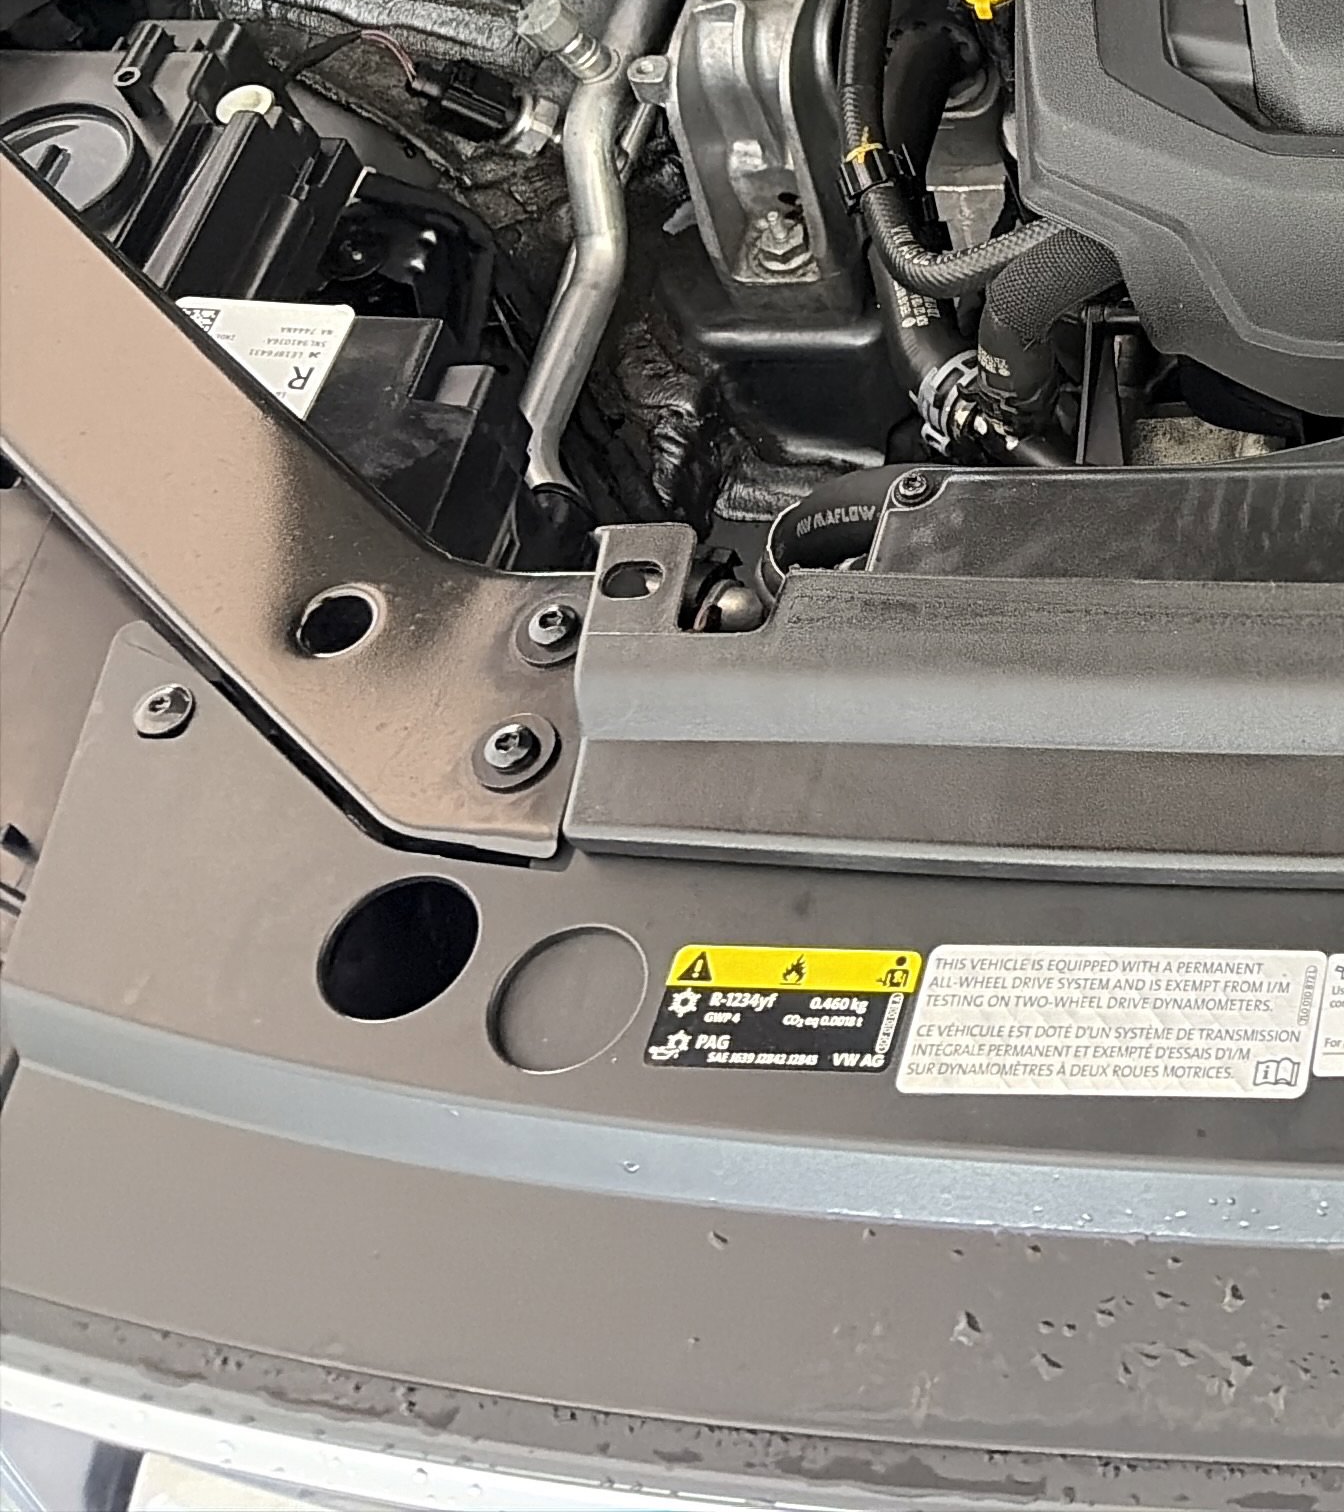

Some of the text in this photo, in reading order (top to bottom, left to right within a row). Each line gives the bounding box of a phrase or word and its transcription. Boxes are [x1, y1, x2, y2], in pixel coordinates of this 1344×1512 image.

[287, 366, 315, 390] R
[813, 505, 876, 529] MAFLOW
[935, 958, 1263, 975] THIS VEHICLE IS EQUIPPED WITH A PERMANENT
[929, 976, 1291, 994] ALL-WHEEL DRIVE SYSTEM AND IS EXEMPT FROM I/M
[708, 992, 869, 1014] R-1234yf 0.460 kg
[926, 994, 1273, 1012] TESTING ON TWO-WHEEL DRIVE DYNAMOMETERS.
[703, 1012, 731, 1024] GWP
[916, 1022, 1301, 1043] CE VÉHICULE EST DOTÉ D'UN SYSTÈME DE TRANSMISSION
[694, 1035, 731, 1050] PAG
[911, 1042, 986, 1056] INTÉGRALE
[987, 1044, 1072, 1057] PERMANENT
[1074, 1045, 1091, 1057] ET
[1092, 1044, 1153, 1059] EXEMPTÉ
[1155, 1046, 1212, 1060] D'ESSAIS
[1324, 1038, 1342, 1048] For
[706, 1051, 730, 1063] SAE
[832, 1053, 859, 1066] VW
[861, 1054, 884, 1067] AG
[906, 1062, 934, 1075] SUR
[937, 1061, 1053, 1077] DYNAMOMÈTRES
[1069, 1064, 1109, 1077] DEUX
[1112, 1064, 1159, 1078] ROUES
[1162, 1065, 1235, 1079] MOTRICES.
